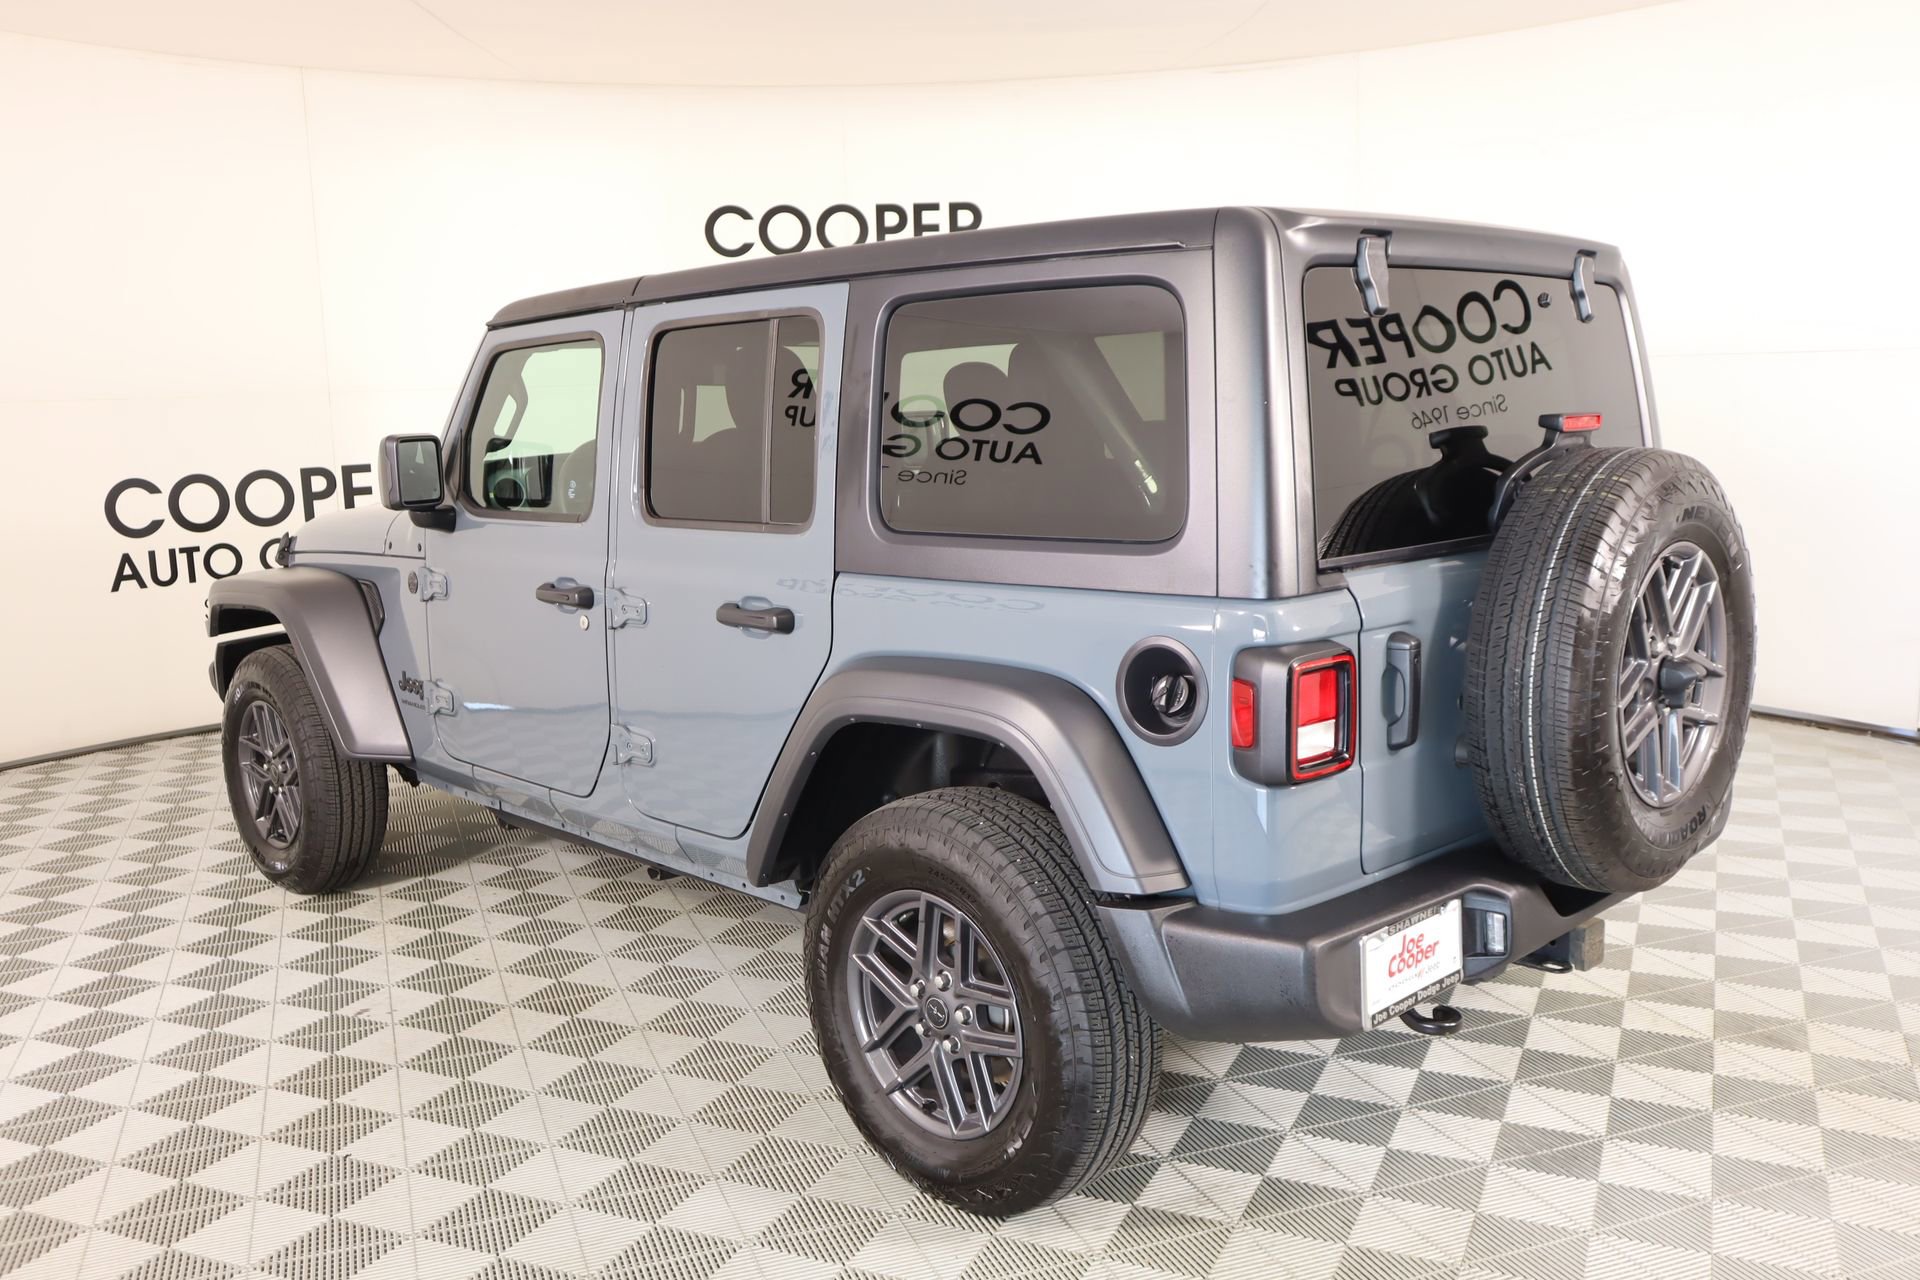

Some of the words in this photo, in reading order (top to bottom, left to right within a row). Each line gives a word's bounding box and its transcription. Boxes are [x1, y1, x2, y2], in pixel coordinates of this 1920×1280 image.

[104, 463, 374, 539] COOPE
[110, 542, 244, 592] AUTO
[1388, 940, 1440, 978] Cooper
[1398, 933, 1425, 959] Joe
[1373, 1013, 1388, 1025] Joe
[1389, 995, 1416, 1016] Cooper
[1417, 983, 1441, 1001] Dodge
